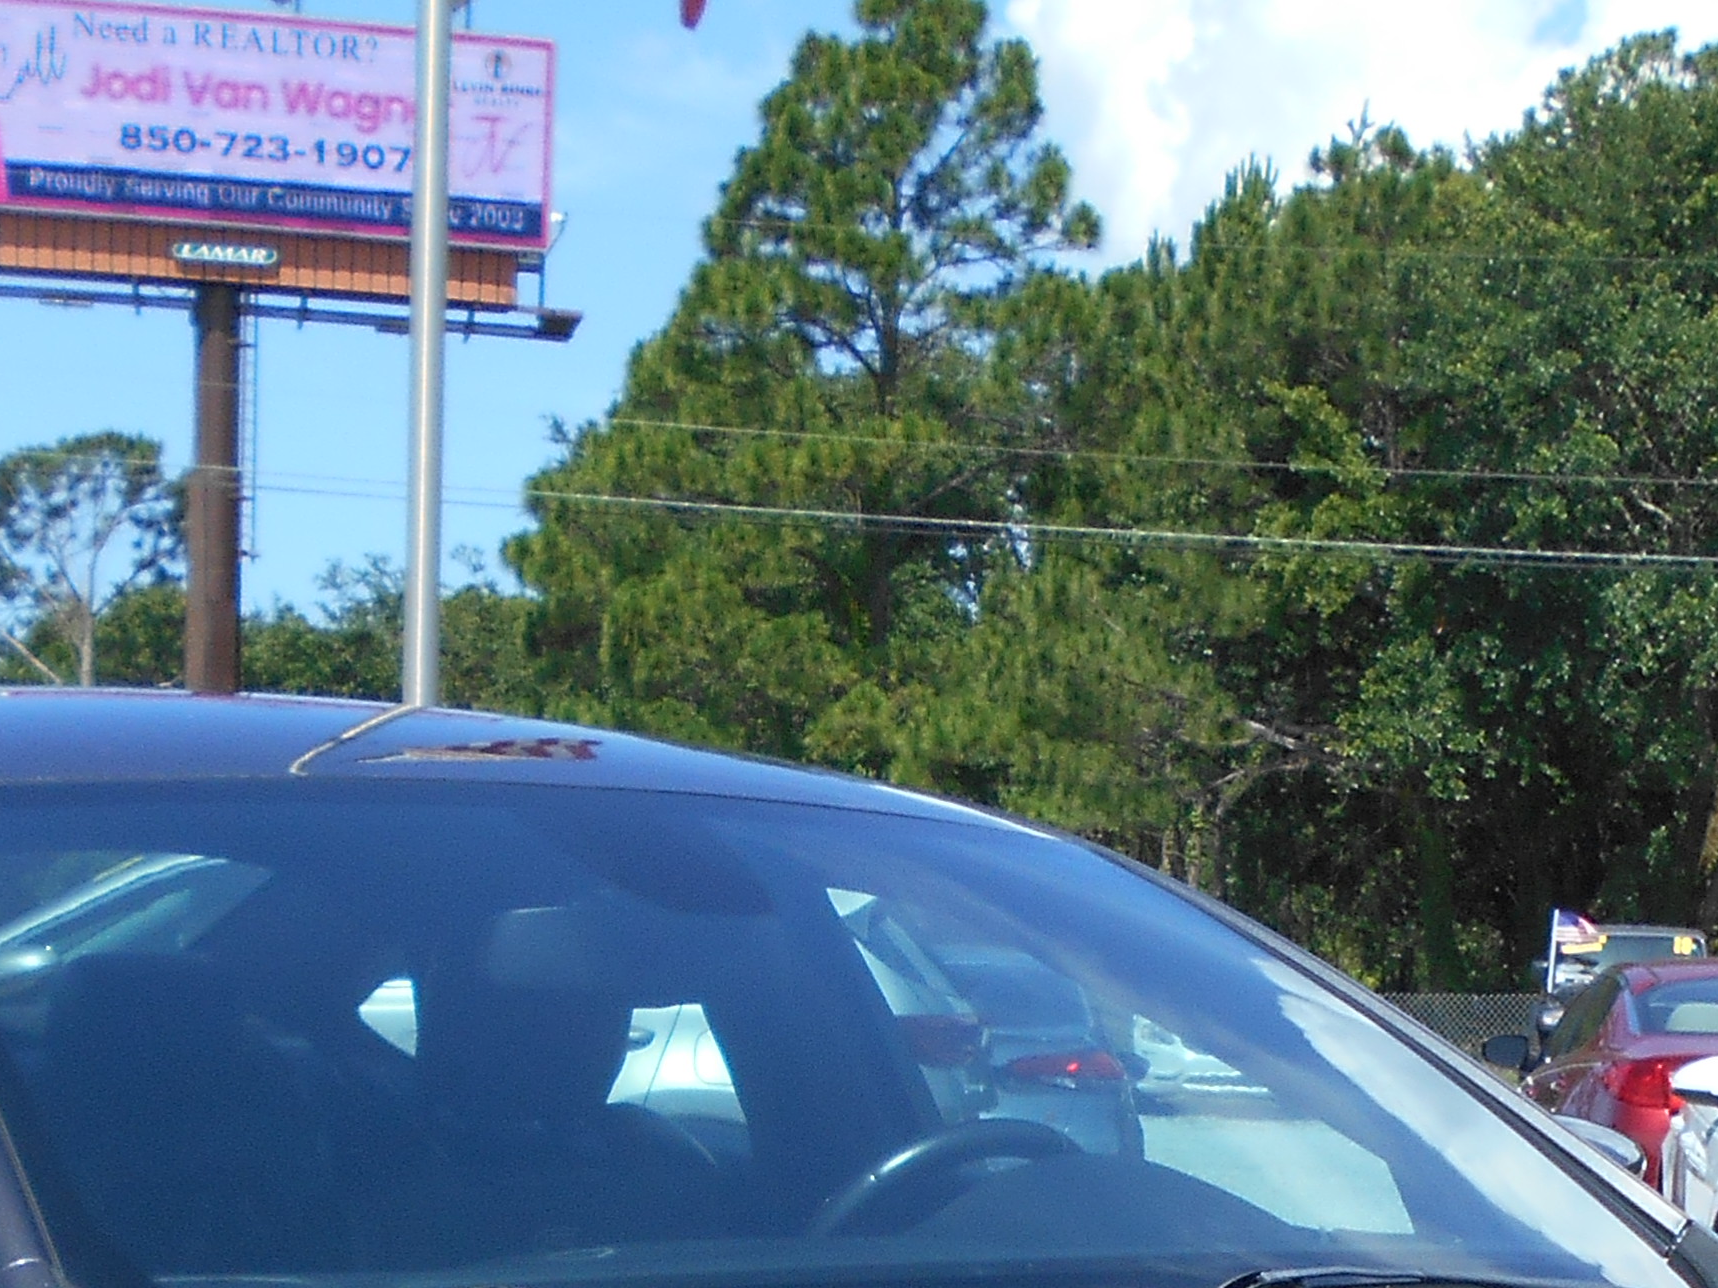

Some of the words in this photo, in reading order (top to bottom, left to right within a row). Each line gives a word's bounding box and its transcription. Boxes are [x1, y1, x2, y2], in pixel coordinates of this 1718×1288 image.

[73, 11, 149, 44] Need
[163, 25, 179, 45] a
[193, 21, 381, 63] REALTOR?
[80, 62, 171, 103] Jodi
[184, 69, 270, 112] Van
[282, 75, 416, 135] Wagn
[118, 122, 411, 174] 850-723-1907
[29, 167, 114, 197] Proudly
[125, 175, 211, 205] Serving
[218, 182, 259, 205] Our
[267, 186, 393, 220] Community
[181, 243, 267, 264] LAMAR
